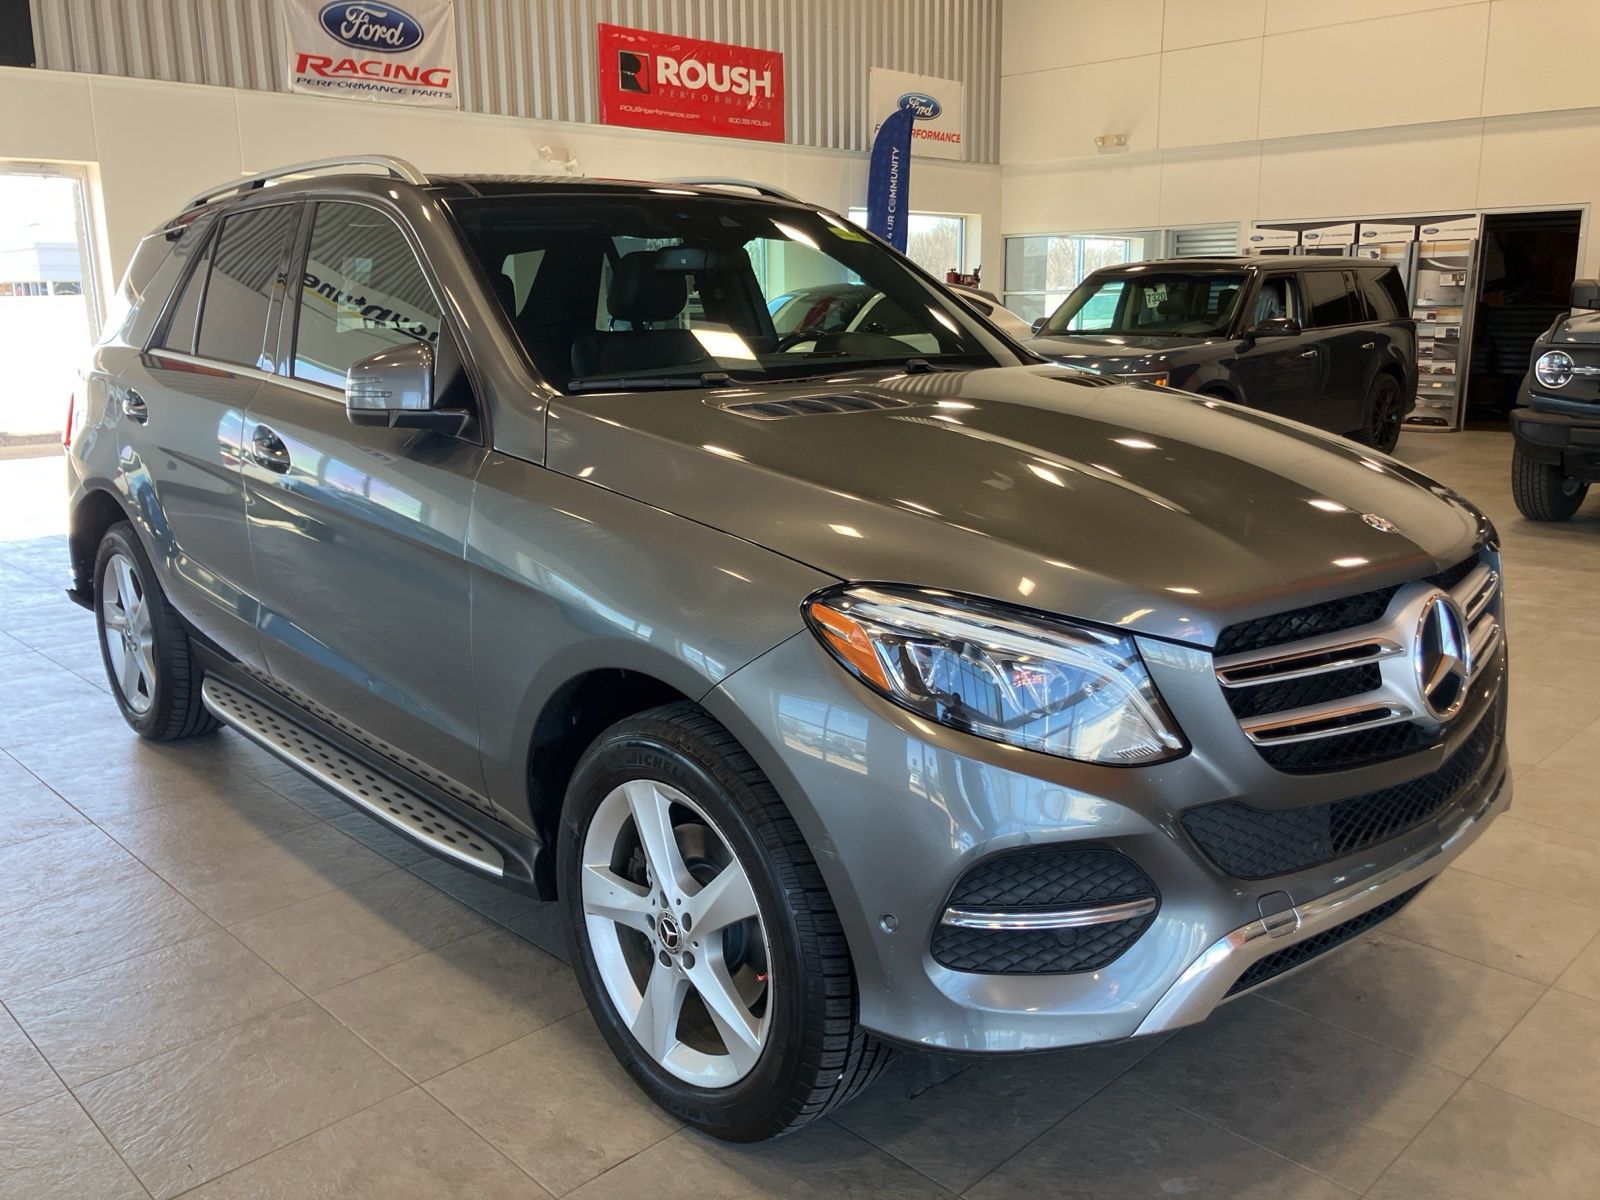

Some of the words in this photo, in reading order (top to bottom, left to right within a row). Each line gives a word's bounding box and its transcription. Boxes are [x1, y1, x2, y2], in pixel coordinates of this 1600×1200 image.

[340, 6, 404, 46] Ford
[296, 53, 451, 88] RACING
[296, 76, 408, 95] PERFORMANCE
[411, 89, 453, 99] PARTS
[656, 55, 772, 98] ROUSH
[911, 128, 960, 143] RFORMANCE
[887, 147, 900, 213] COMMUNITY
[1146, 291, 1166, 303] 7320
